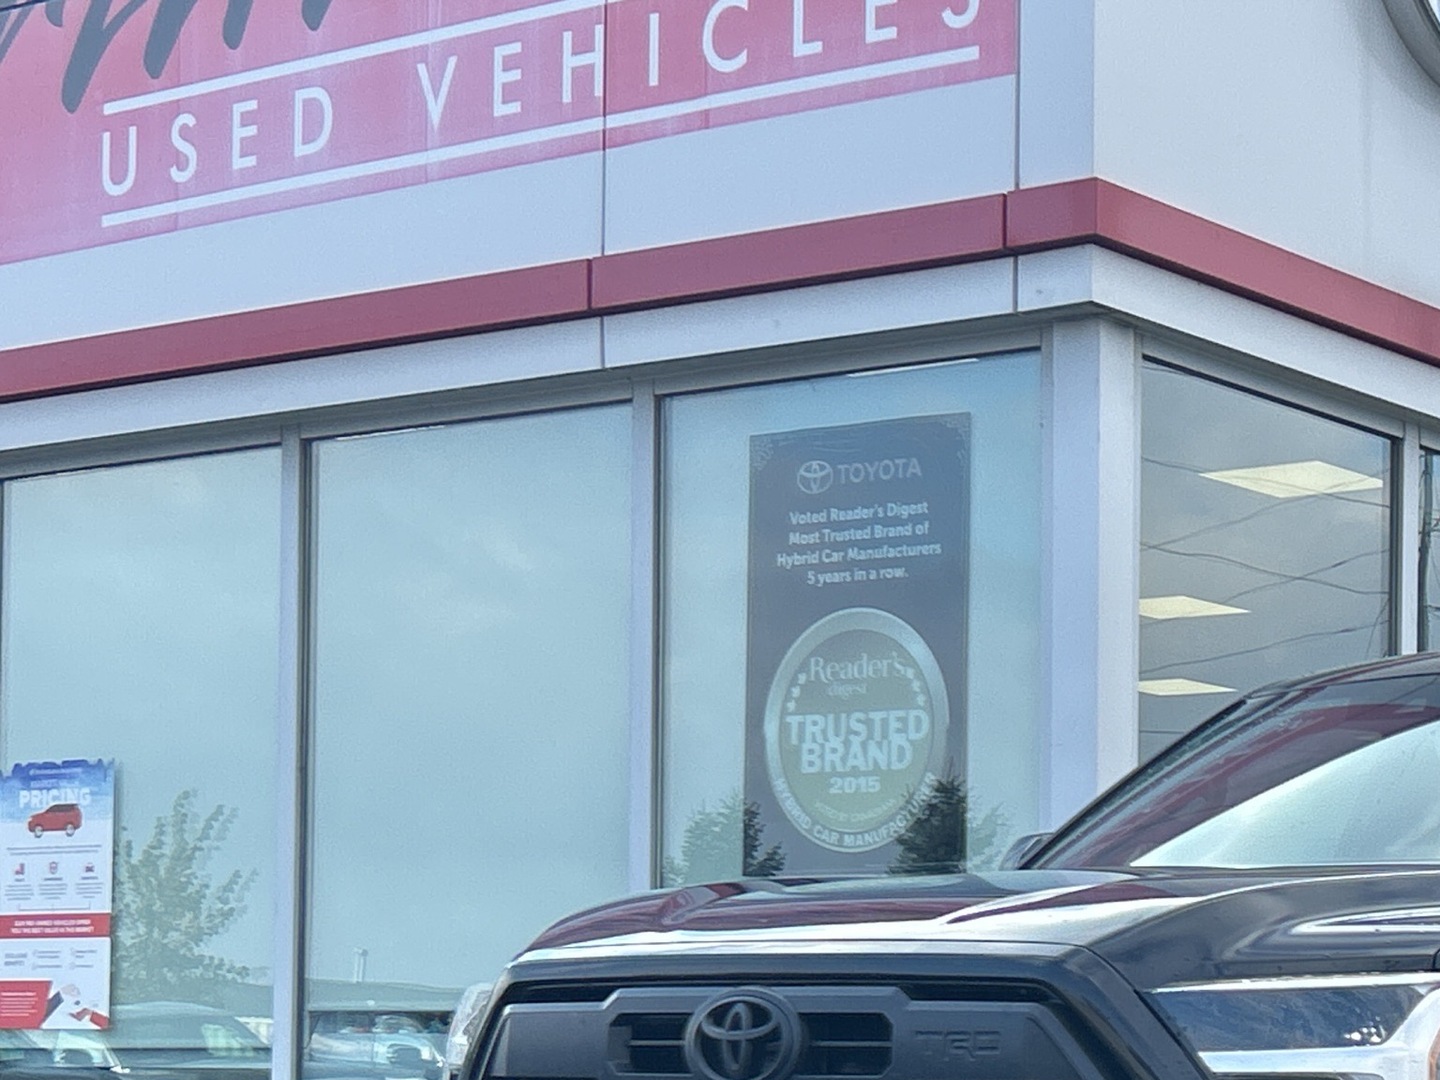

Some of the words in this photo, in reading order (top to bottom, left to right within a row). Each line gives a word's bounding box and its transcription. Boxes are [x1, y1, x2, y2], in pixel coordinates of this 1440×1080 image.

[101, 86, 334, 198] USED
[837, 457, 922, 484] TOYOTA
[788, 508, 827, 525] Voted
[829, 503, 884, 522] Reader's
[886, 501, 929, 519] Digest
[788, 531, 820, 545] Most
[821, 525, 872, 543] Trusted
[874, 522, 912, 539] Brand
[915, 520, 930, 536] of
[776, 549, 820, 570] Hybrid
[821, 548, 845, 563] Car
[847, 543, 942, 561] Manufacturers
[806, 570, 816, 585] 5
[817, 570, 852, 588] years
[853, 566, 867, 581] in
[808, 652, 904, 684] Reader's
[784, 708, 931, 745] TRUSTED
[801, 732, 914, 774] BRAND
[19, 787, 92, 809] PRICING
[829, 775, 881, 794] 2015
[813, 824, 840, 846] CAR
[914, 1029, 1002, 1062] TRD
